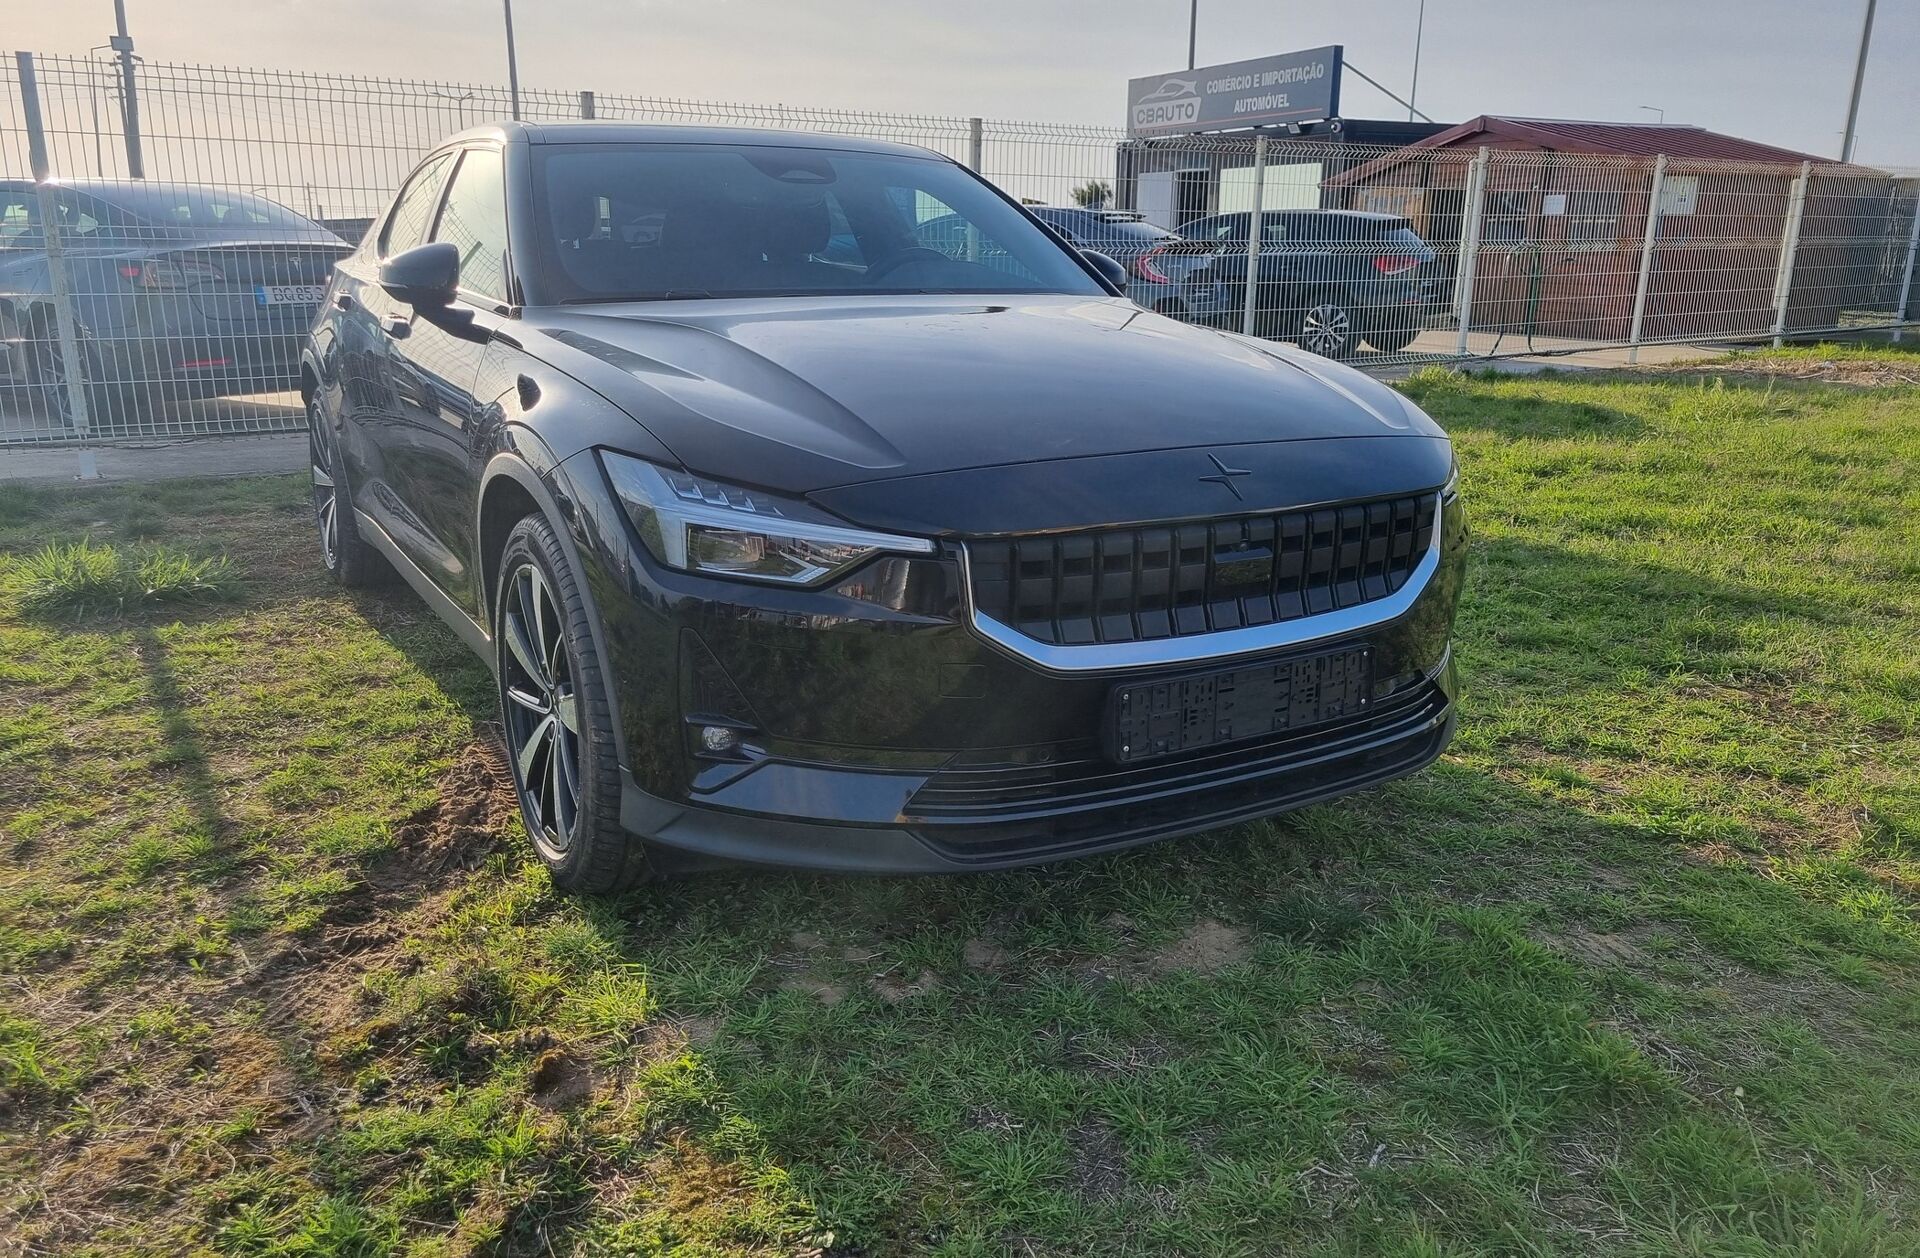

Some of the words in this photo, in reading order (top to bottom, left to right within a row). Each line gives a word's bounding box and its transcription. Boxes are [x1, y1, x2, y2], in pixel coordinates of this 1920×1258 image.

[1206, 75, 1252, 94] COMÉRCIO
[1253, 73, 1260, 88] E
[1261, 62, 1324, 87] IMPORTAÇÃO
[1136, 102, 1195, 124] CBAUTO
[1233, 92, 1290, 113] AUTOMÓVEL
